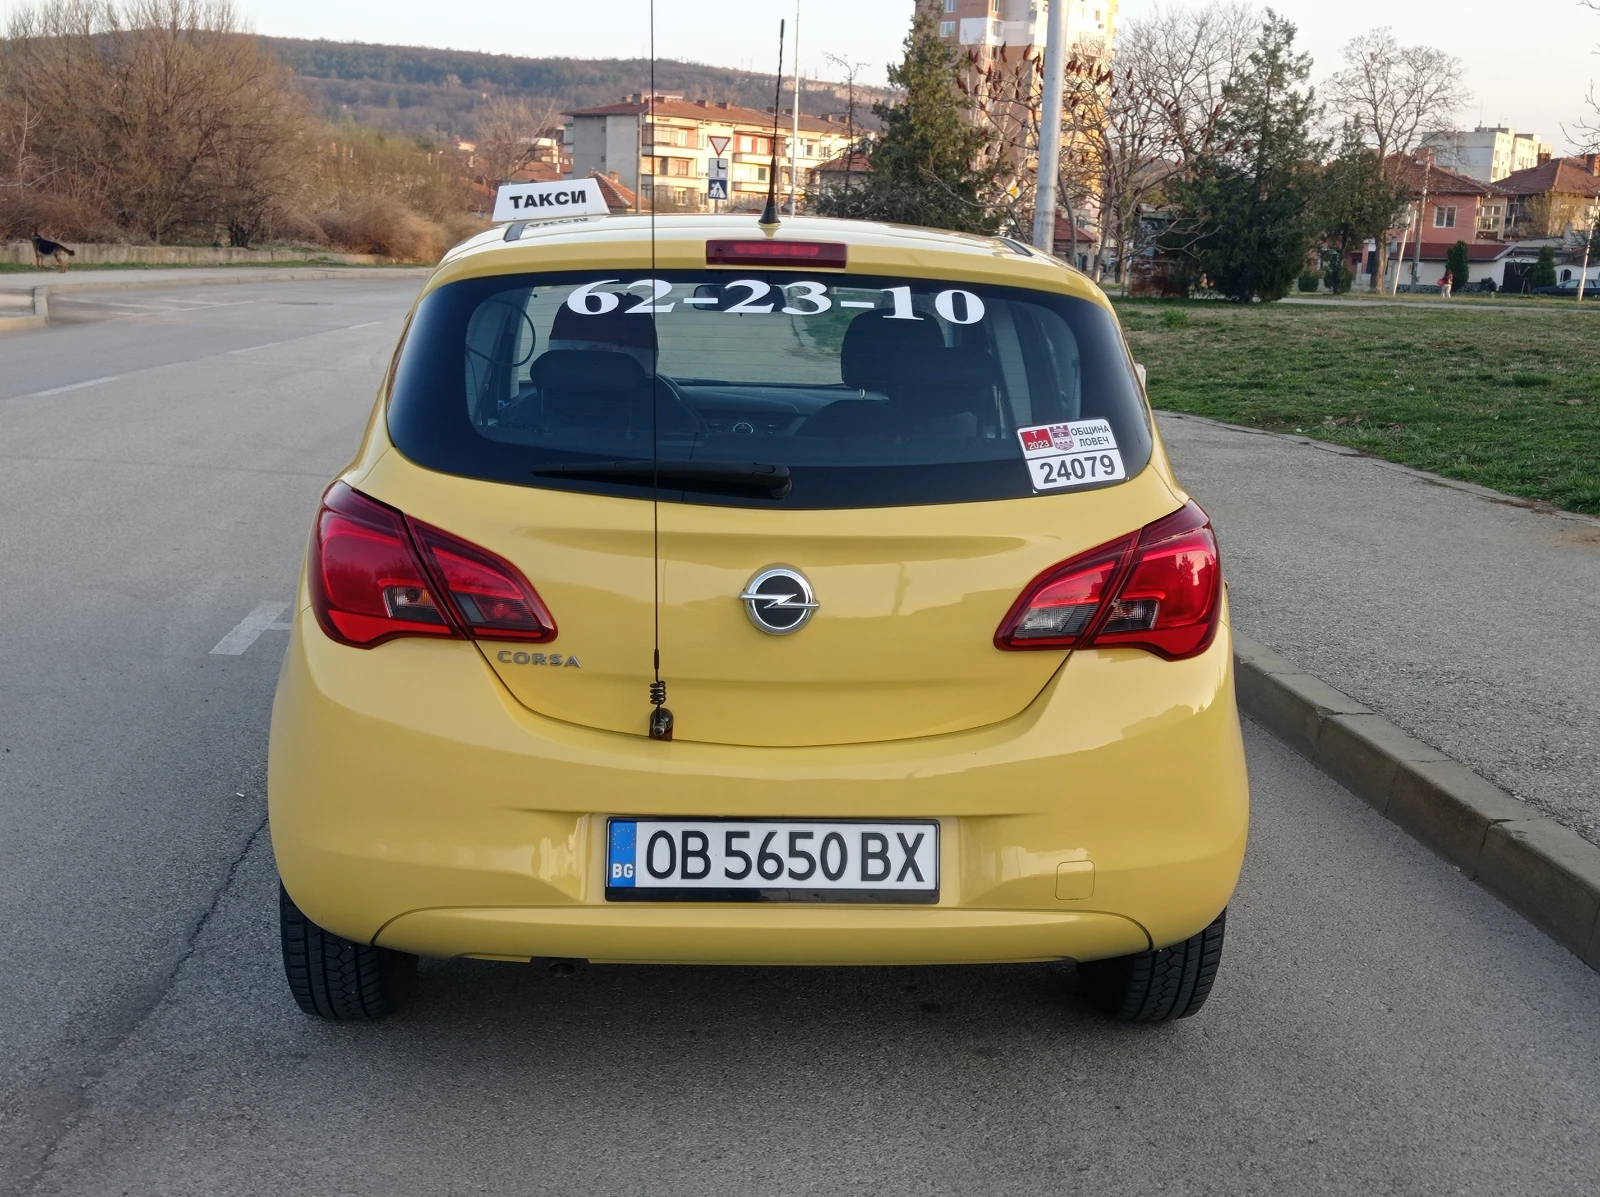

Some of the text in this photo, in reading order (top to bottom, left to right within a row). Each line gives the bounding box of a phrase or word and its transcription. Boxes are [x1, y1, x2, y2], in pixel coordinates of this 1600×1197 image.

[509, 190, 587, 209] ТАКСИ
[566, 279, 986, 325] 62-23-10
[1070, 425, 1111, 436] ОБЩИНА
[1027, 440, 1050, 450] 2023
[1079, 436, 1110, 447] ЛОВЕЧ
[1039, 454, 1116, 484] 24079
[497, 650, 582, 668] CORSA
[724, 830, 848, 882] 5650
[612, 863, 634, 879] BG
